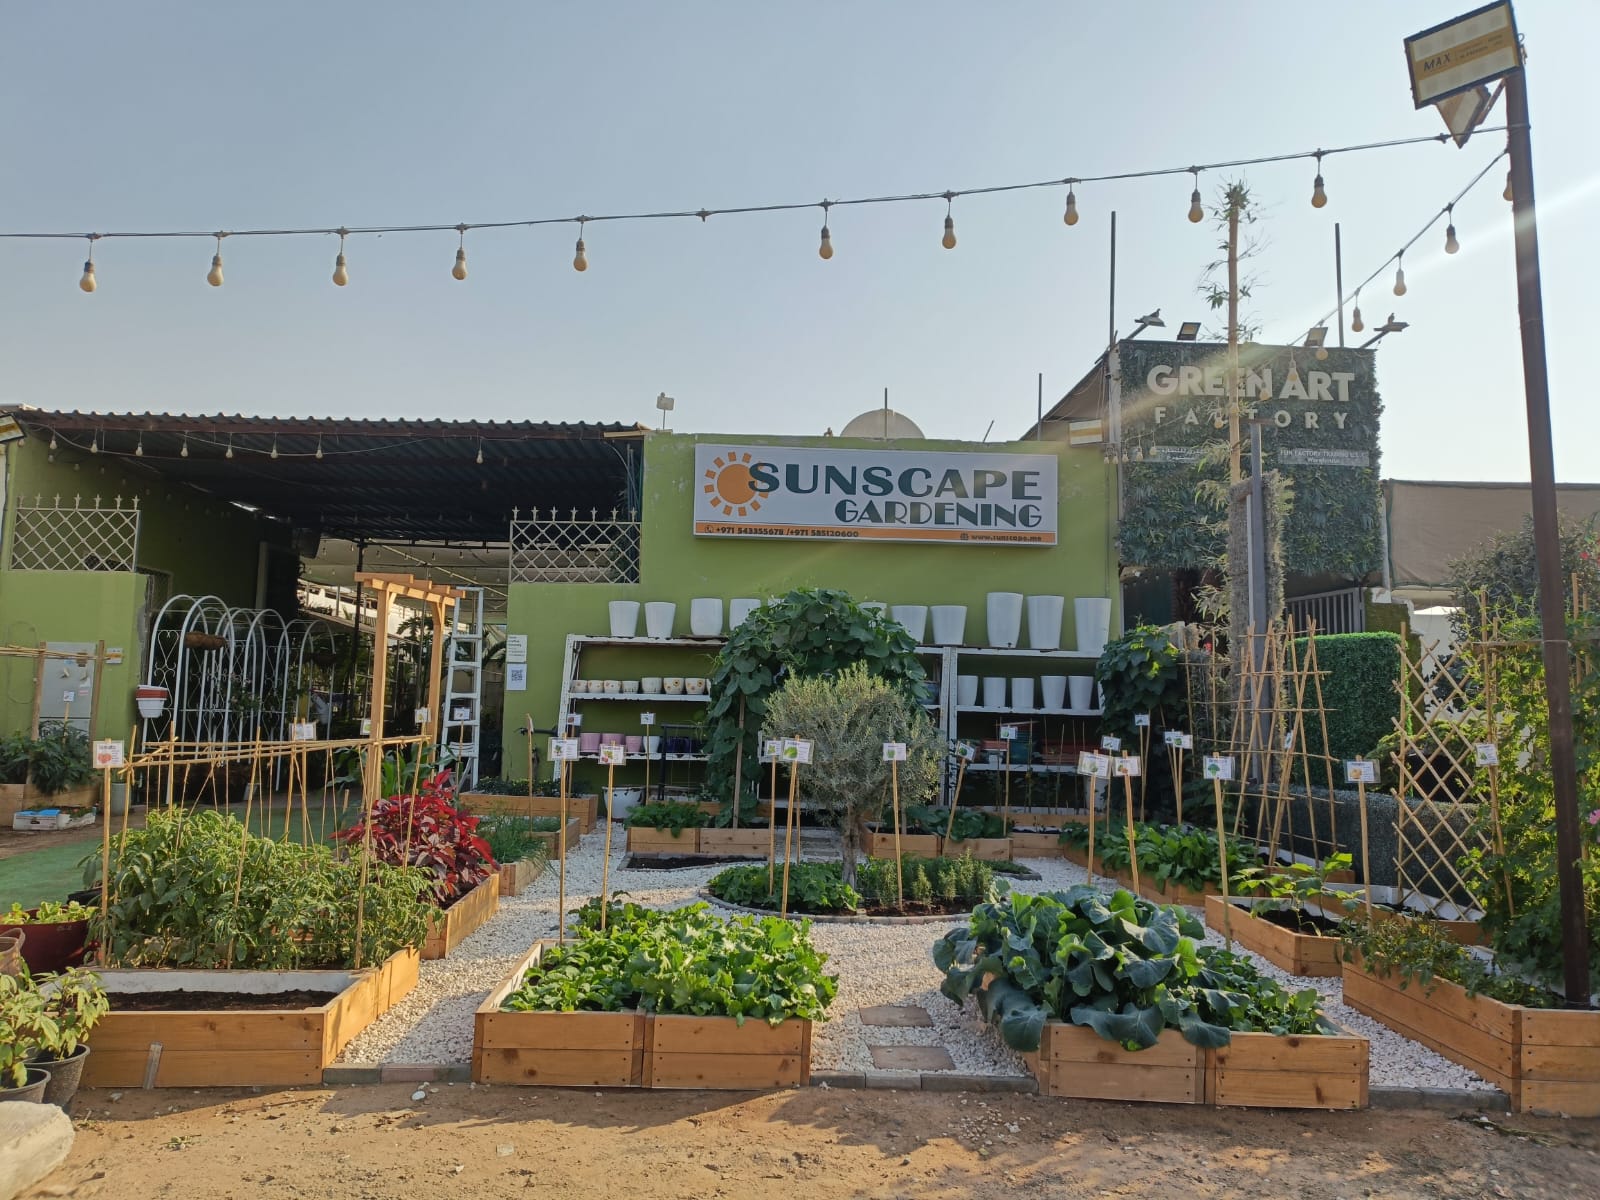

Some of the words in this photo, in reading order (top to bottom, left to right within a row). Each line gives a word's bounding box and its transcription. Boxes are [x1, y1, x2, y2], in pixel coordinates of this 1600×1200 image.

[1147, 364, 1273, 398] GREEN
[1279, 367, 1355, 401] ART
[748, 462, 1042, 500] SUNSCAPE
[834, 499, 1042, 527] GARDENING
[716, 526, 735, 534] +971
